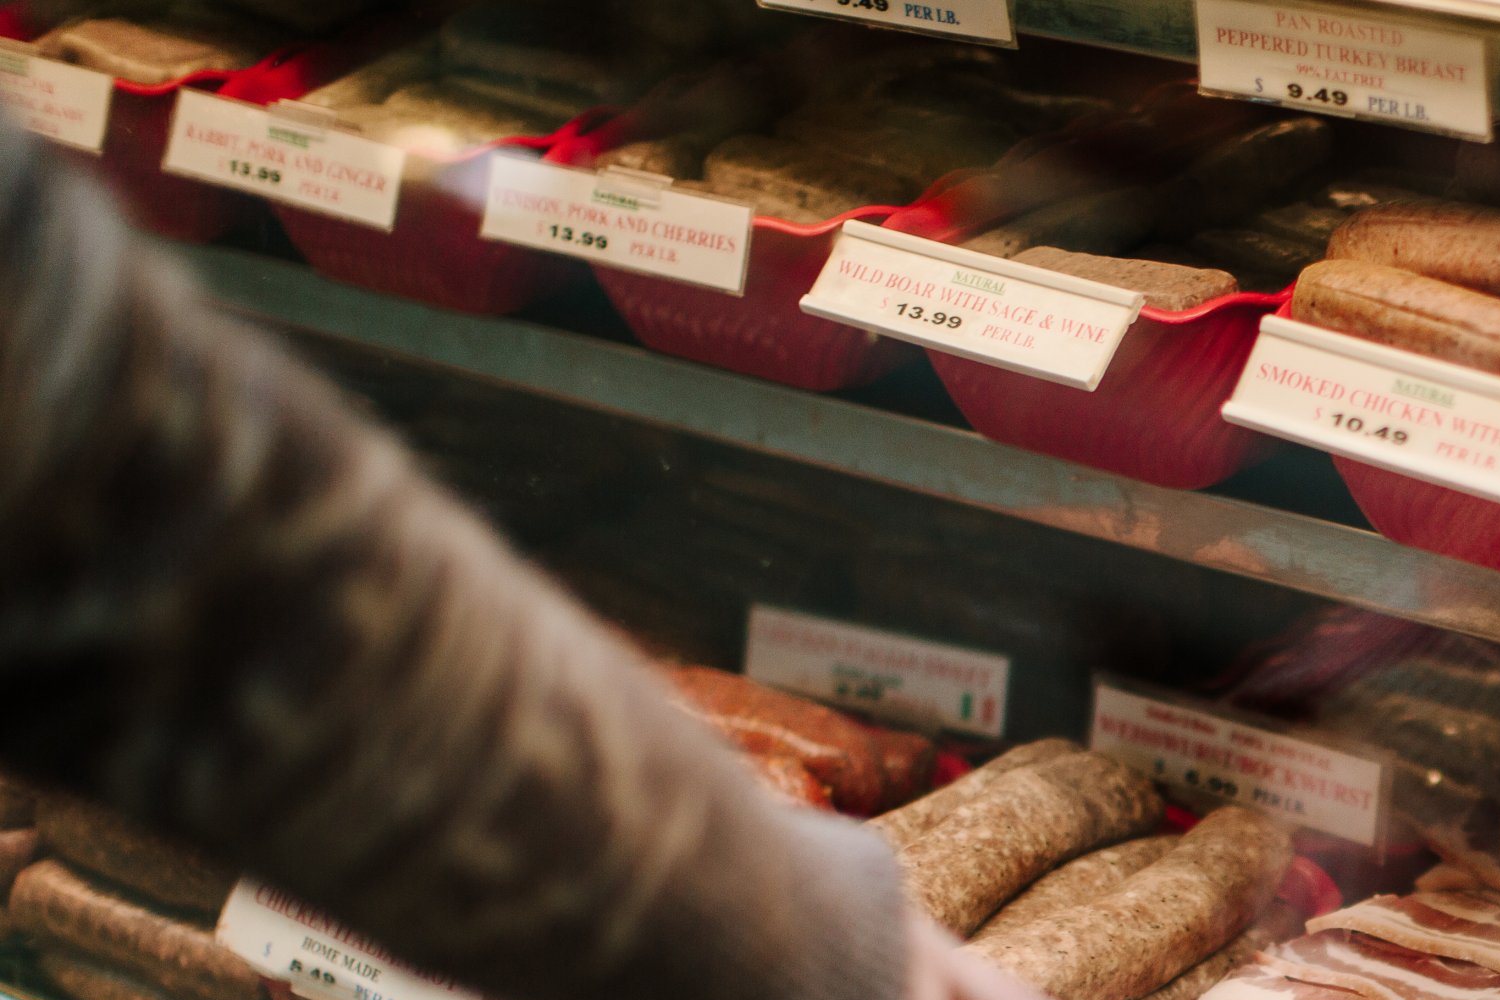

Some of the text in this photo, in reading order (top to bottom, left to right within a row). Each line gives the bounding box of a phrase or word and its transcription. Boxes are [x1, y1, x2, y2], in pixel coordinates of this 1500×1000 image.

[837, 0, 961, 25] .49 PER LB.
[1275, 11, 1404, 48] PAN ROASTED
[1215, 27, 1467, 82] PEPPERED TURKEY BREAST
[1296, 63, 1322, 79] 99%
[1352, 73, 1386, 90] FREE
[1255, 77, 1430, 121] $ 9.49 PER LB.
[549, 223, 608, 251] 13.99
[567, 202, 609, 228] PORK
[615, 214, 649, 235] AND
[652, 219, 737, 254] CHERRIES
[838, 259, 1111, 345] WILD BOAR WITH SAGE & WINE
[951, 270, 1007, 297] NATURAL
[879, 296, 1037, 351] $ 13.99 PER LB.
[1255, 362, 1347, 402] SMOKED
[1348, 388, 1446, 430] CHICKEN
[1331, 411, 1411, 447] 10.49
[1435, 441, 1471, 465] PER
[301, 936, 383, 983] HOME MADE
